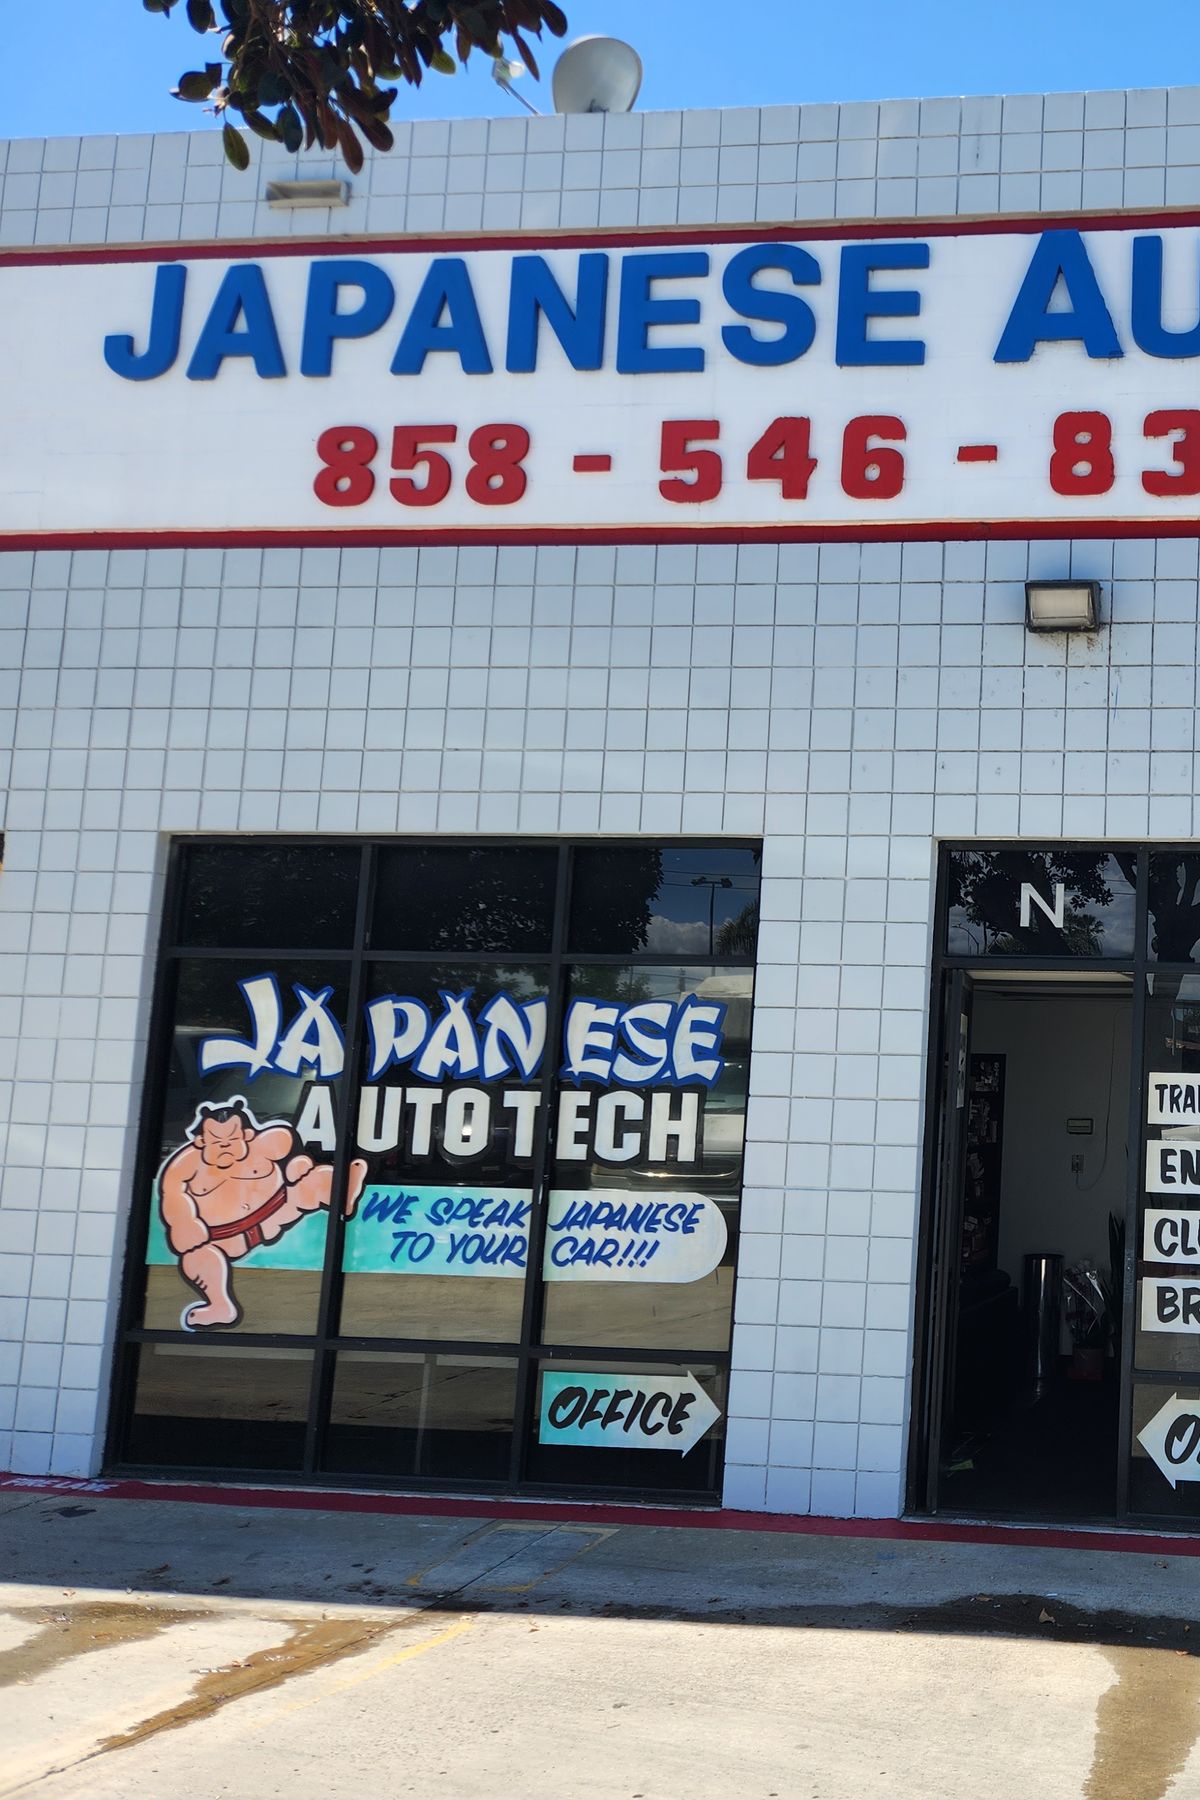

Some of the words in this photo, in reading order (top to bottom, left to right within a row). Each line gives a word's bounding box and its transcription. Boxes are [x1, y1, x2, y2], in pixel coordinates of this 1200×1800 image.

[103, 242, 930, 381] JAPANESE
[1020, 882, 1064, 928] N
[199, 972, 725, 1088] JAPANESE
[298, 1085, 491, 1157] AUTO
[503, 1090, 697, 1162] TECH
[362, 1192, 419, 1223] WE
[425, 1196, 532, 1230] SPEAK
[548, 1201, 705, 1234] JAPANESE
[392, 1232, 434, 1262] TO
[448, 1233, 527, 1267] YOUR
[551, 1237, 661, 1268] CAR!!!
[548, 1386, 697, 1434] OFFICE
